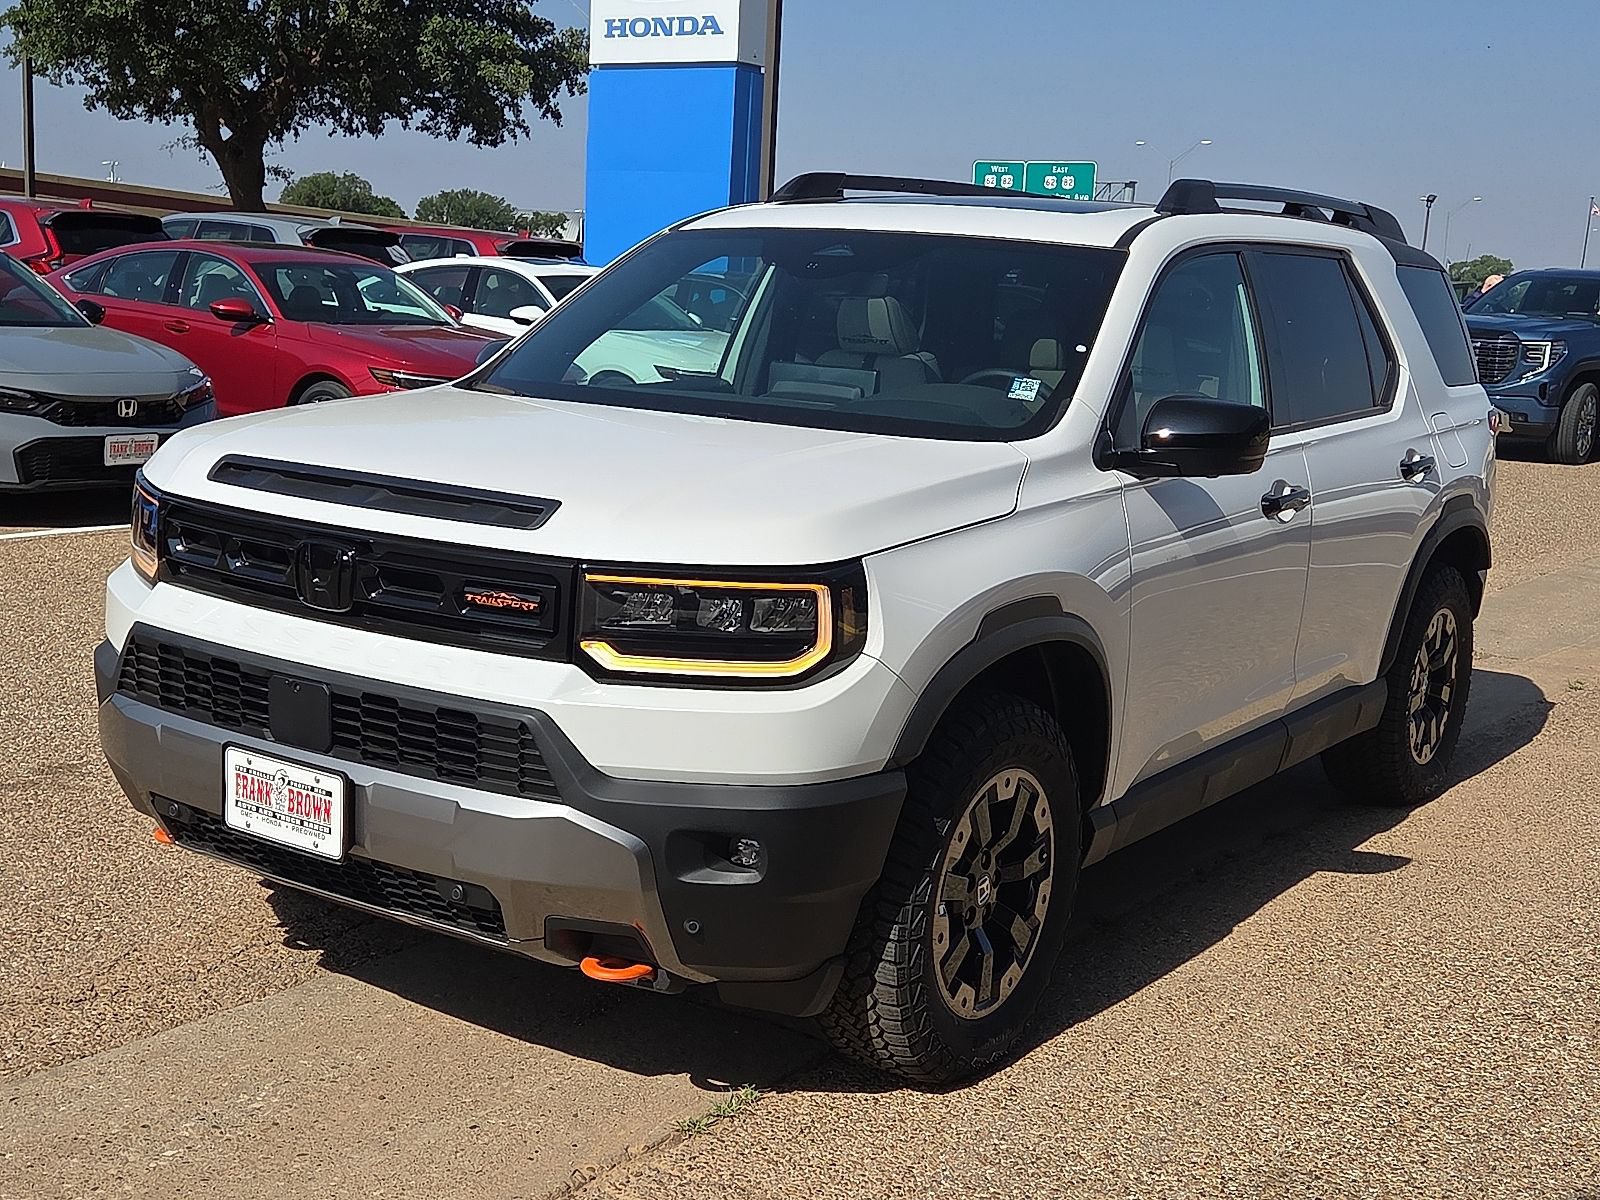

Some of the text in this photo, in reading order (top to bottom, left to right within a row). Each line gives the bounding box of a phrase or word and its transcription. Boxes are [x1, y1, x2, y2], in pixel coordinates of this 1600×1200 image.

[604, 15, 724, 38] HONDA
[991, 165, 1008, 173] WEST
[1052, 165, 1069, 174] EAST
[986, 177, 1012, 185] 62 82
[1046, 178, 1073, 187] 62 82
[464, 594, 539, 611] TRAILSPORT
[235, 772, 273, 807] FRANK
[287, 788, 332, 824] BROWN
[237, 800, 256, 811] AUTO
[258, 806, 273, 817] AND
[240, 809, 326, 841] GMC HONDA PREOWNED
